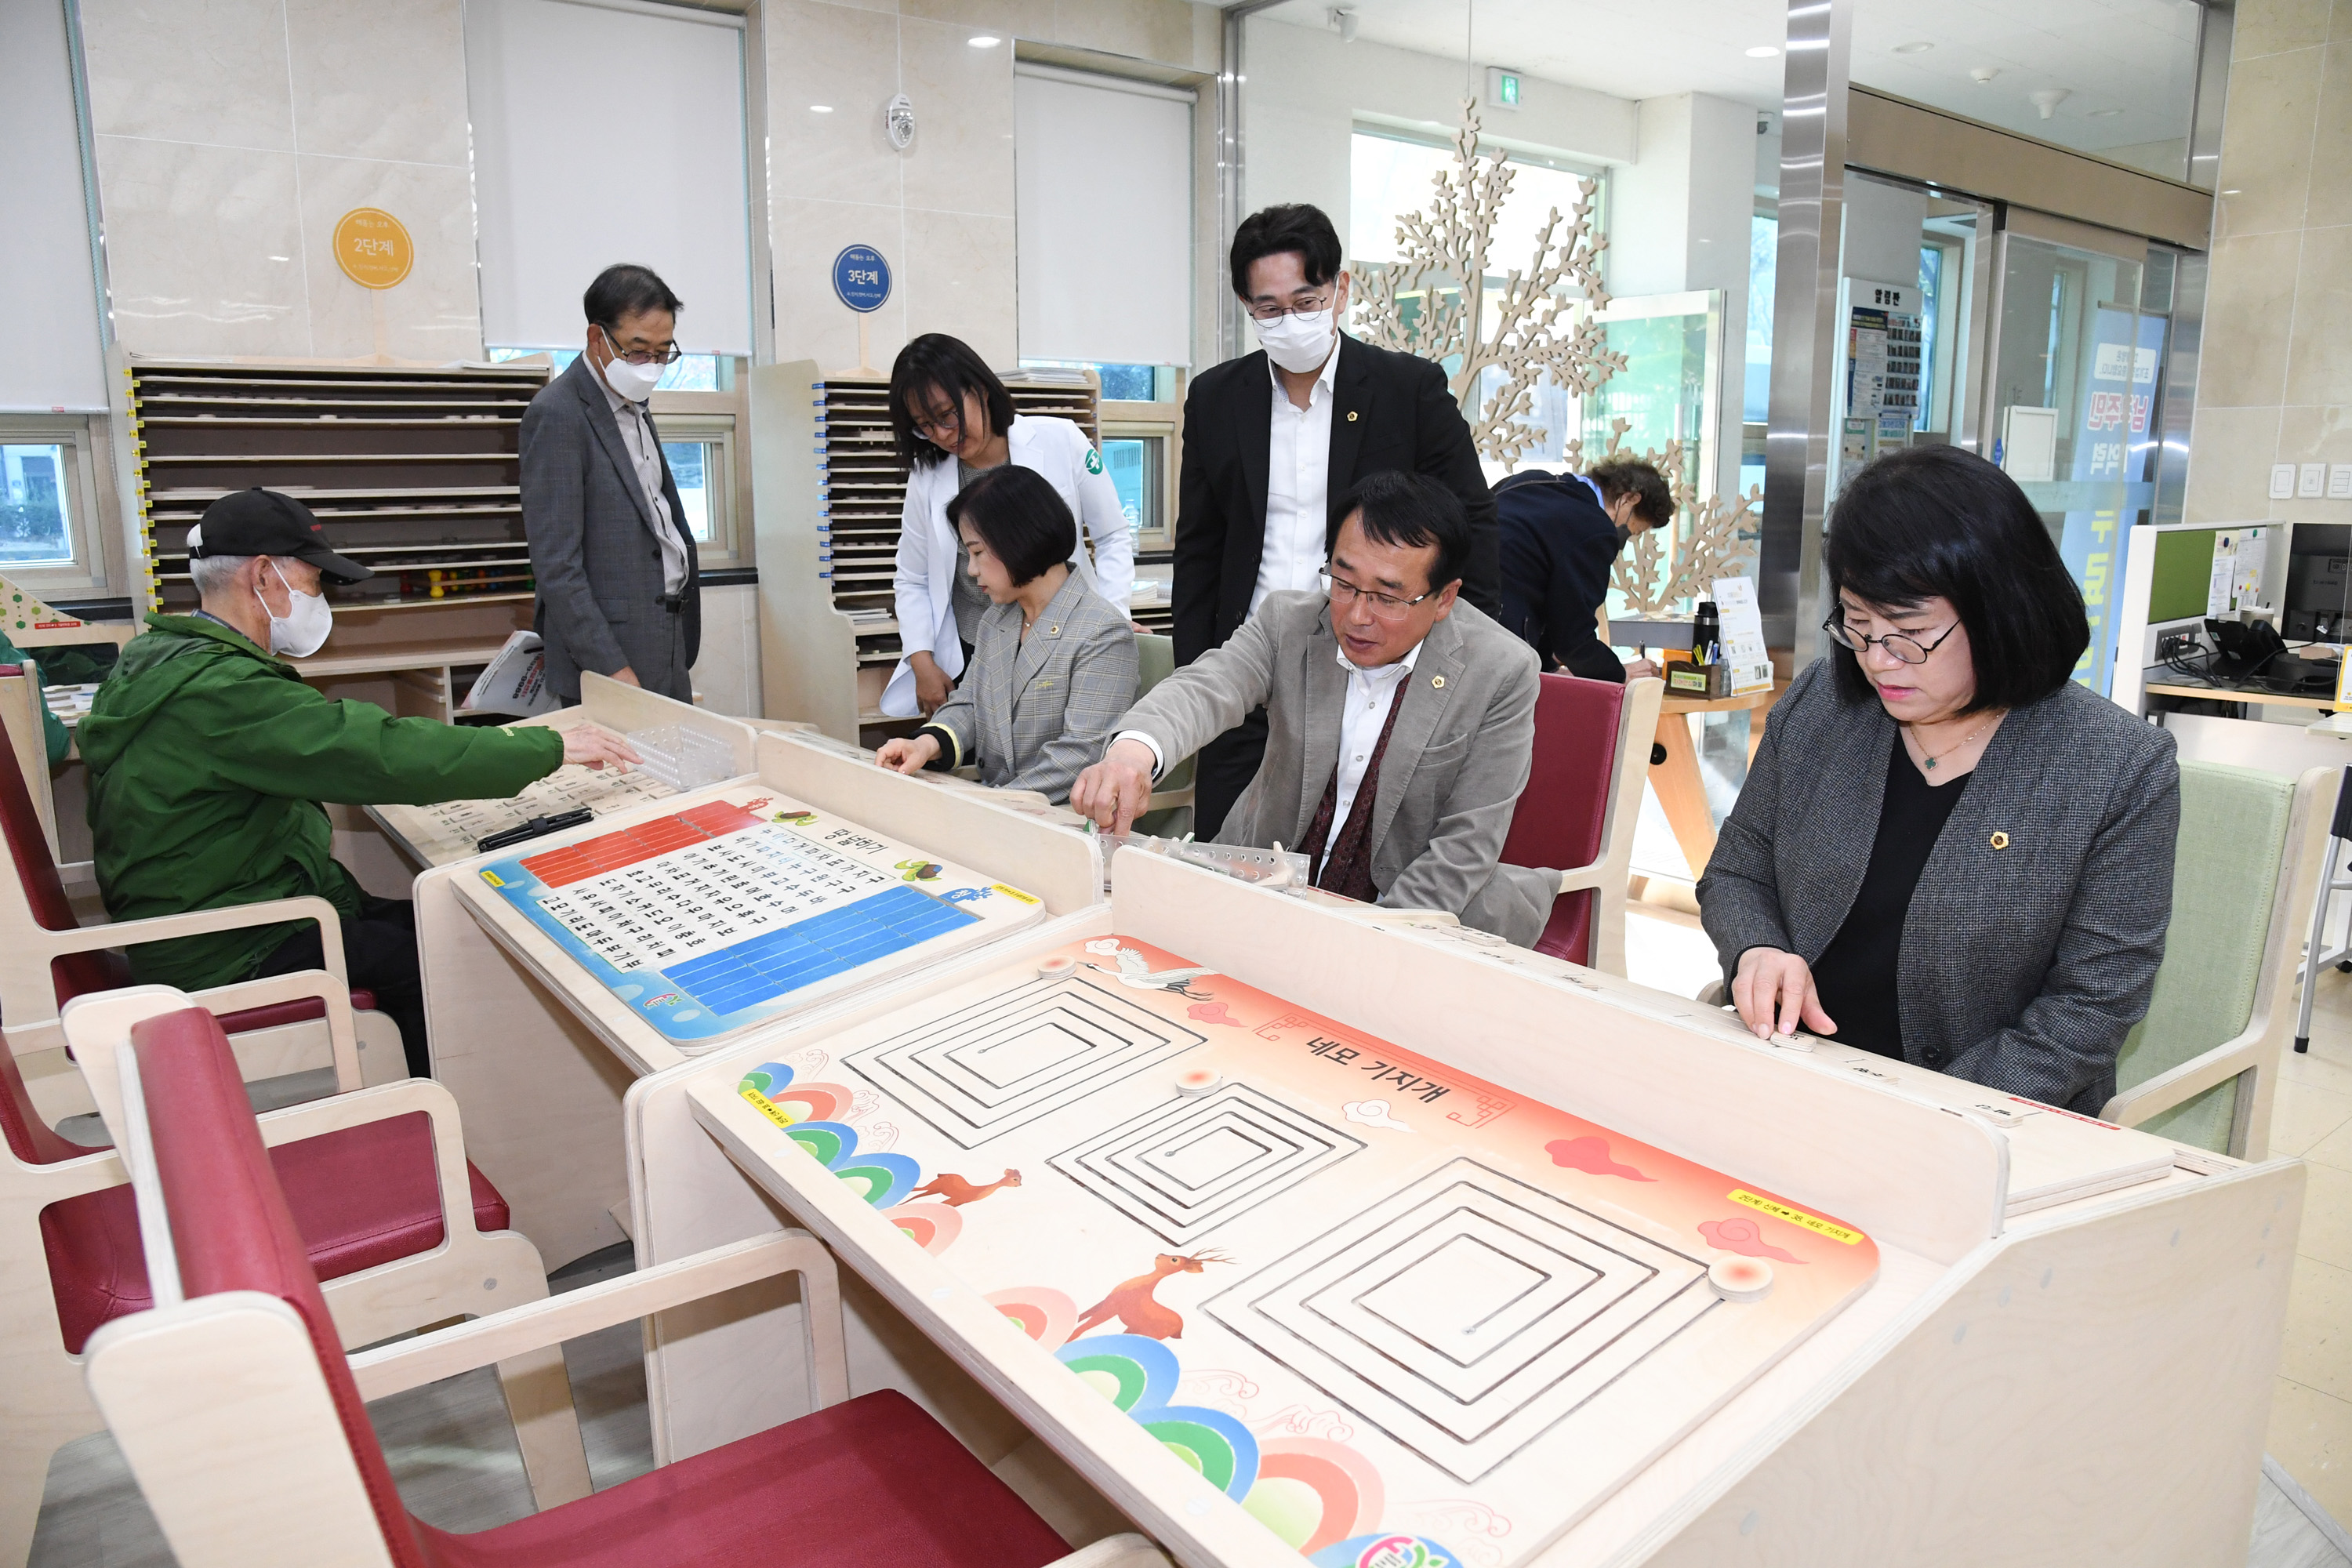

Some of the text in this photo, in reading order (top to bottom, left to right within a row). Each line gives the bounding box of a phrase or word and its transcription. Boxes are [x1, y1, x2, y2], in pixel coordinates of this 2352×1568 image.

[354, 238, 394, 256] 2단계
[848, 270, 878, 285] 3단계
[1875, 289, 1900, 307] 알림판
[824, 828, 888, 855] 땅 넓히기
[1306, 1036, 1451, 1104] 네모 기지개
[1806, 1219, 1823, 1229] 네모
[1825, 1226, 1851, 1239] 기지개
